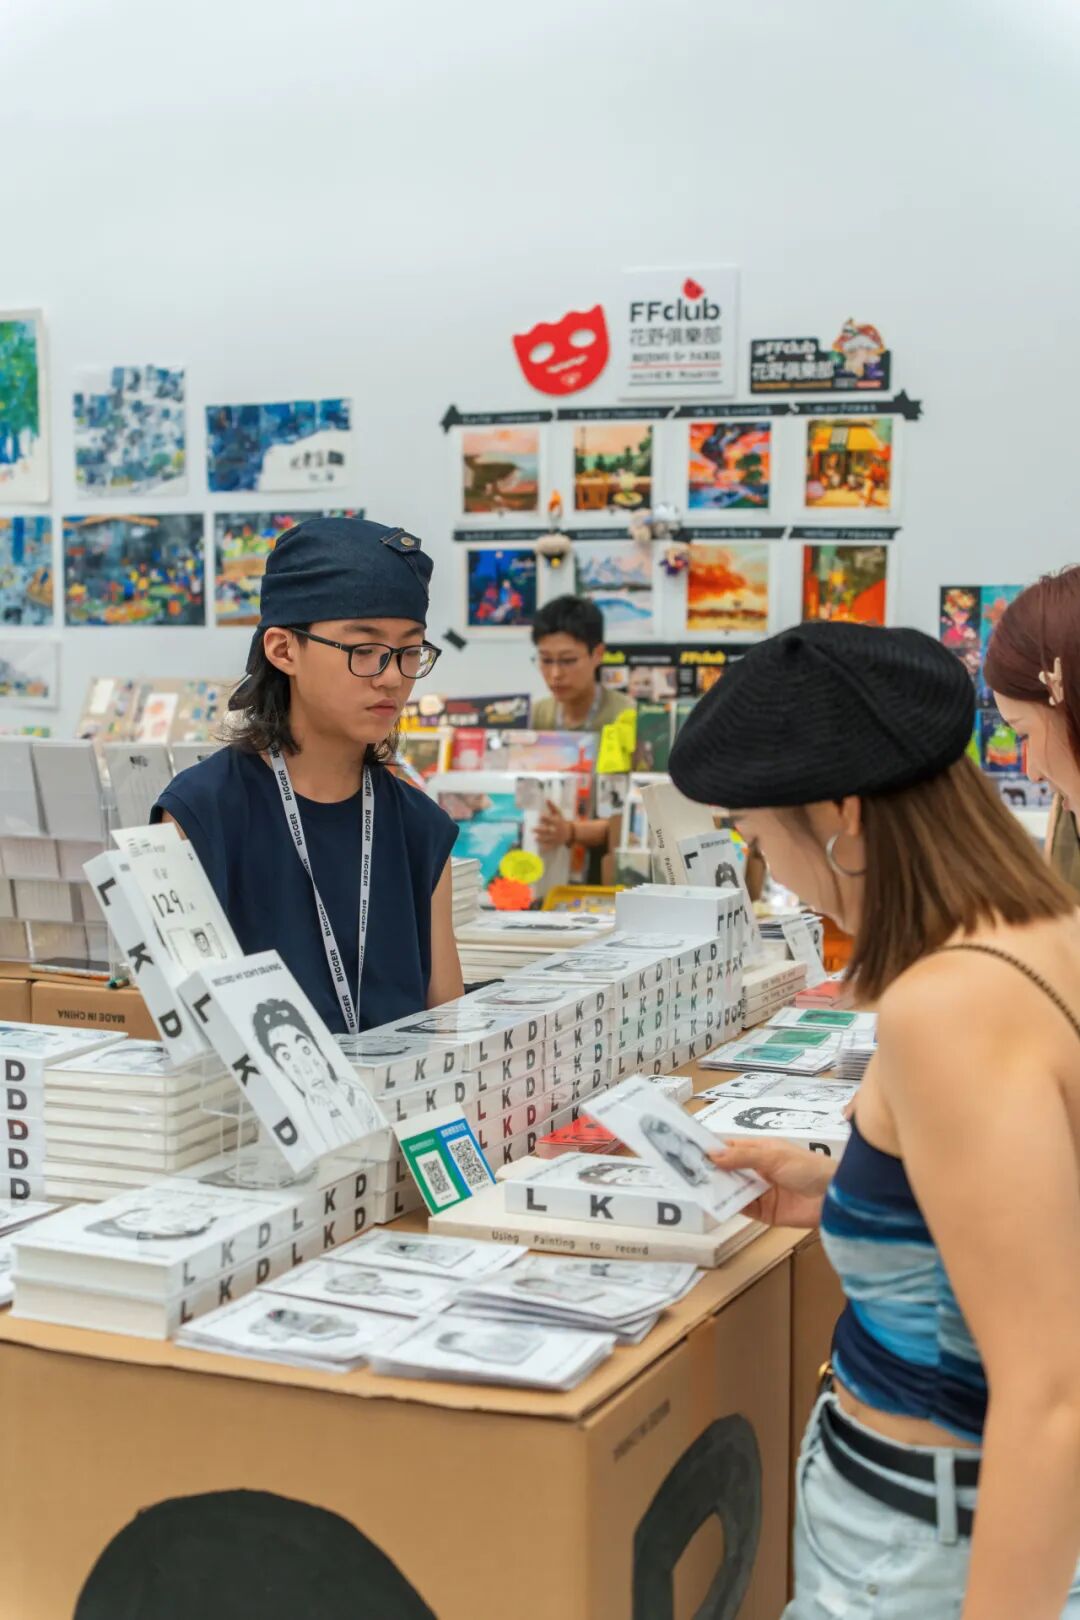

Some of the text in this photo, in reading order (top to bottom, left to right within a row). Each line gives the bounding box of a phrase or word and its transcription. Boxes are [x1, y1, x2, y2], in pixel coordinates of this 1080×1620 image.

[630, 298, 720, 322] FFclub
[278, 770, 292, 802] BIGGER
[290, 812, 303, 846] BIGGER
[152, 889, 185, 918] 129
[330, 948, 344, 983] BIGGER
[58, 1008, 125, 1024] MADE IN CHINA
[342, 994, 356, 1028] BIGGER
[5, 1059, 25, 1082] D
[7, 1088, 27, 1110] D
[7, 1119, 28, 1140] D
[8, 1148, 28, 1170] D
[10, 1178, 30, 1200] D
[526, 1188, 682, 1226] L K D
[492, 1230, 649, 1255] Using Painting to record
